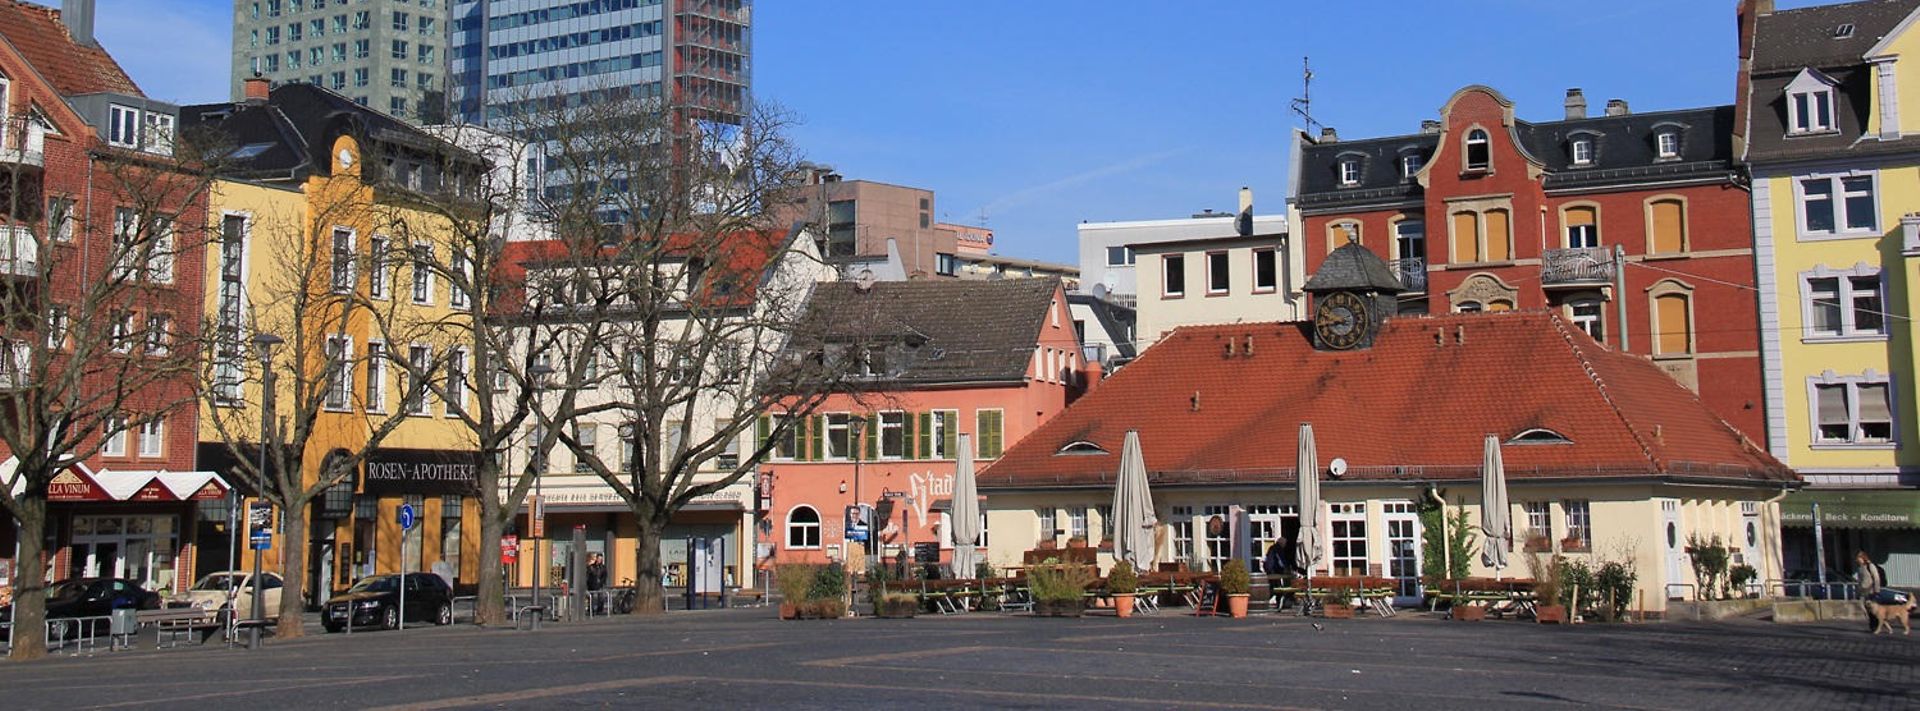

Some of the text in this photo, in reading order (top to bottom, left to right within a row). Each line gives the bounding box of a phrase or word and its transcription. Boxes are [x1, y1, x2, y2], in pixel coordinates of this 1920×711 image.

[368, 462, 476, 480] ROSEN-APOTHEKE
[48, 484, 91, 494] LLA VINUM
[910, 470, 957, 528] Stad
[1781, 512, 1813, 520] äckerei
[1825, 513, 1848, 521] Beck
[1860, 513, 1909, 521] Konditorei
